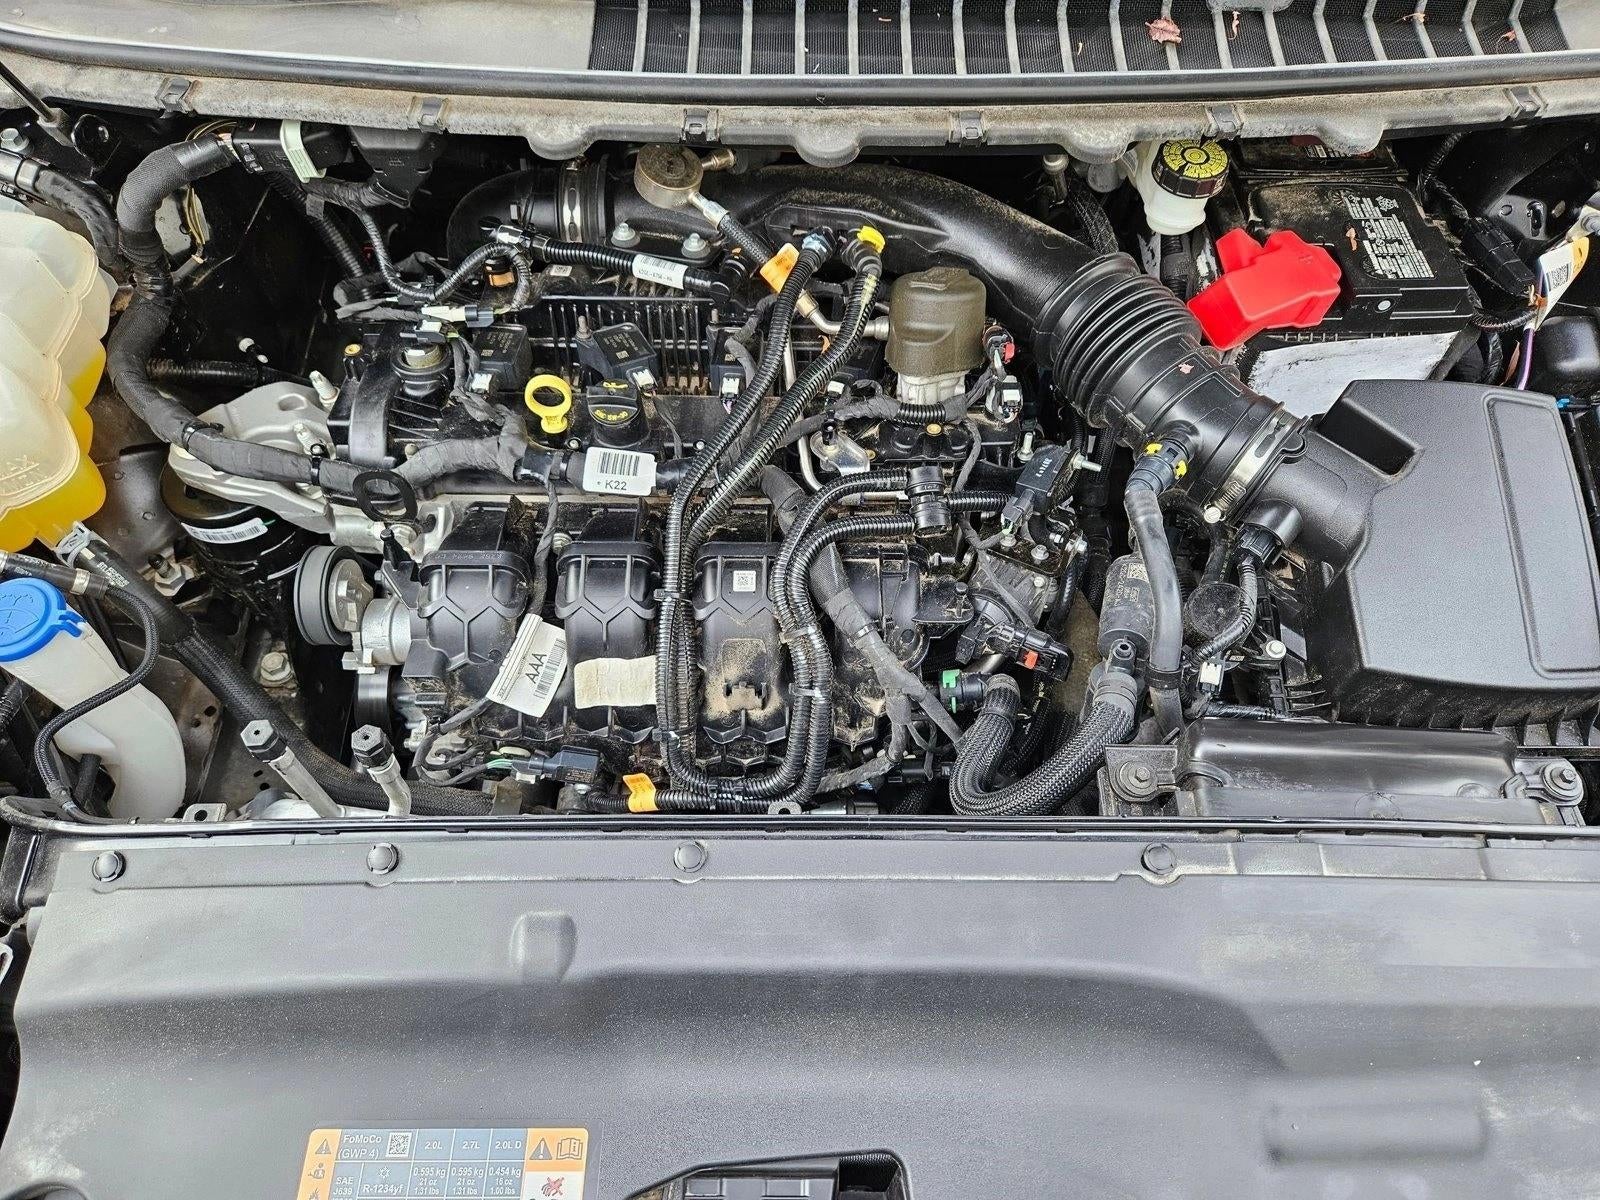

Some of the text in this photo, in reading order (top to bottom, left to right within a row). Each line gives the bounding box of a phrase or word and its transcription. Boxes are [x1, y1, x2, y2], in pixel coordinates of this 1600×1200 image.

[605, 480, 627, 491] K22
[525, 653, 547, 684] AAA
[343, 1134, 382, 1144] FoMoCo
[424, 1140, 443, 1150] 2.0L
[462, 1140, 481, 1150] 2.7L
[495, 1140, 522, 1150] 2.0L D
[337, 1148, 367, 1160] (GWP
[413, 1167, 446, 1178] 0.595 kg
[451, 1167, 485, 1178] 0.595 kg
[489, 1167, 522, 1178] 0.454 kg
[336, 1177, 355, 1185] SAE
[419, 1178, 427, 1186] 21
[457, 1178, 466, 1186] 21
[362, 1184, 404, 1196] R-1234yf
[428, 1187, 440, 1195] lbs
[467, 1187, 478, 1195] lbs
[505, 1187, 516, 1195] lbs
